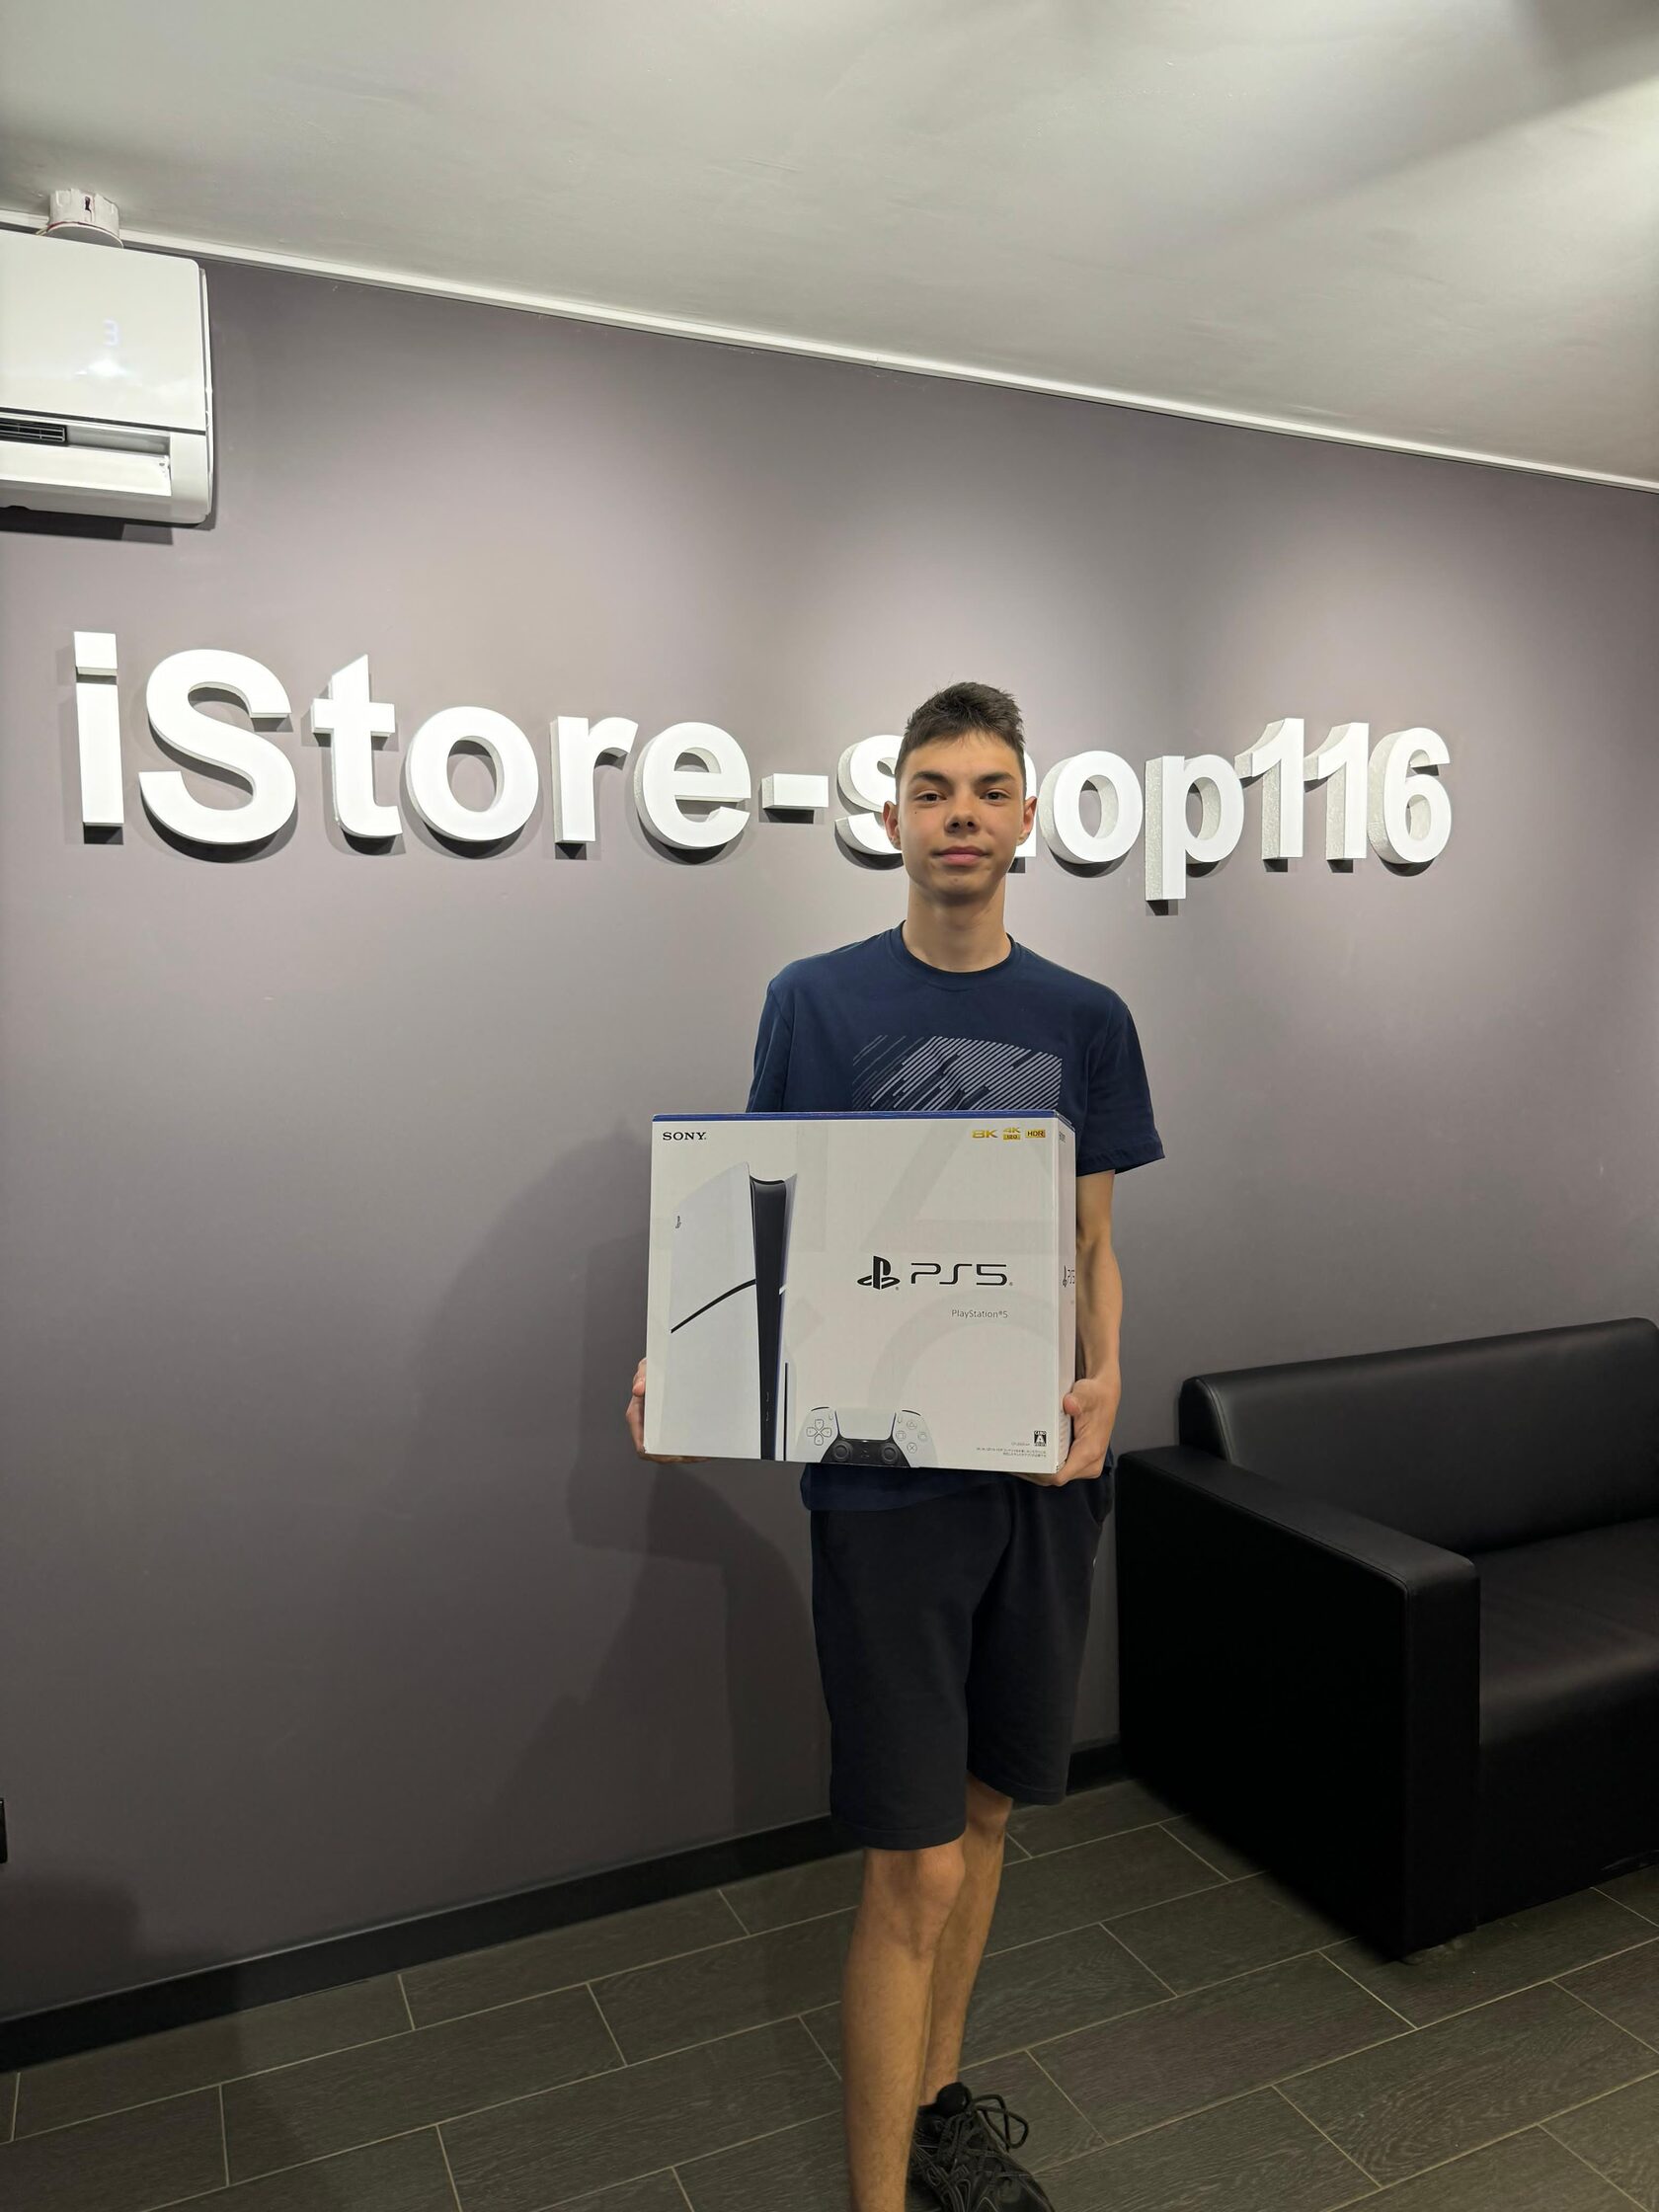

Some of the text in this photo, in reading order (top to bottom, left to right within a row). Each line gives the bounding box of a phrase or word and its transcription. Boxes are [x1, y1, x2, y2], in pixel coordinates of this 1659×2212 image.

[72, 631, 1452, 902] iStore-sop116
[663, 1132, 706, 1141] SONY
[972, 1130, 997, 1139] 8K
[910, 1262, 1008, 1286] PS5
